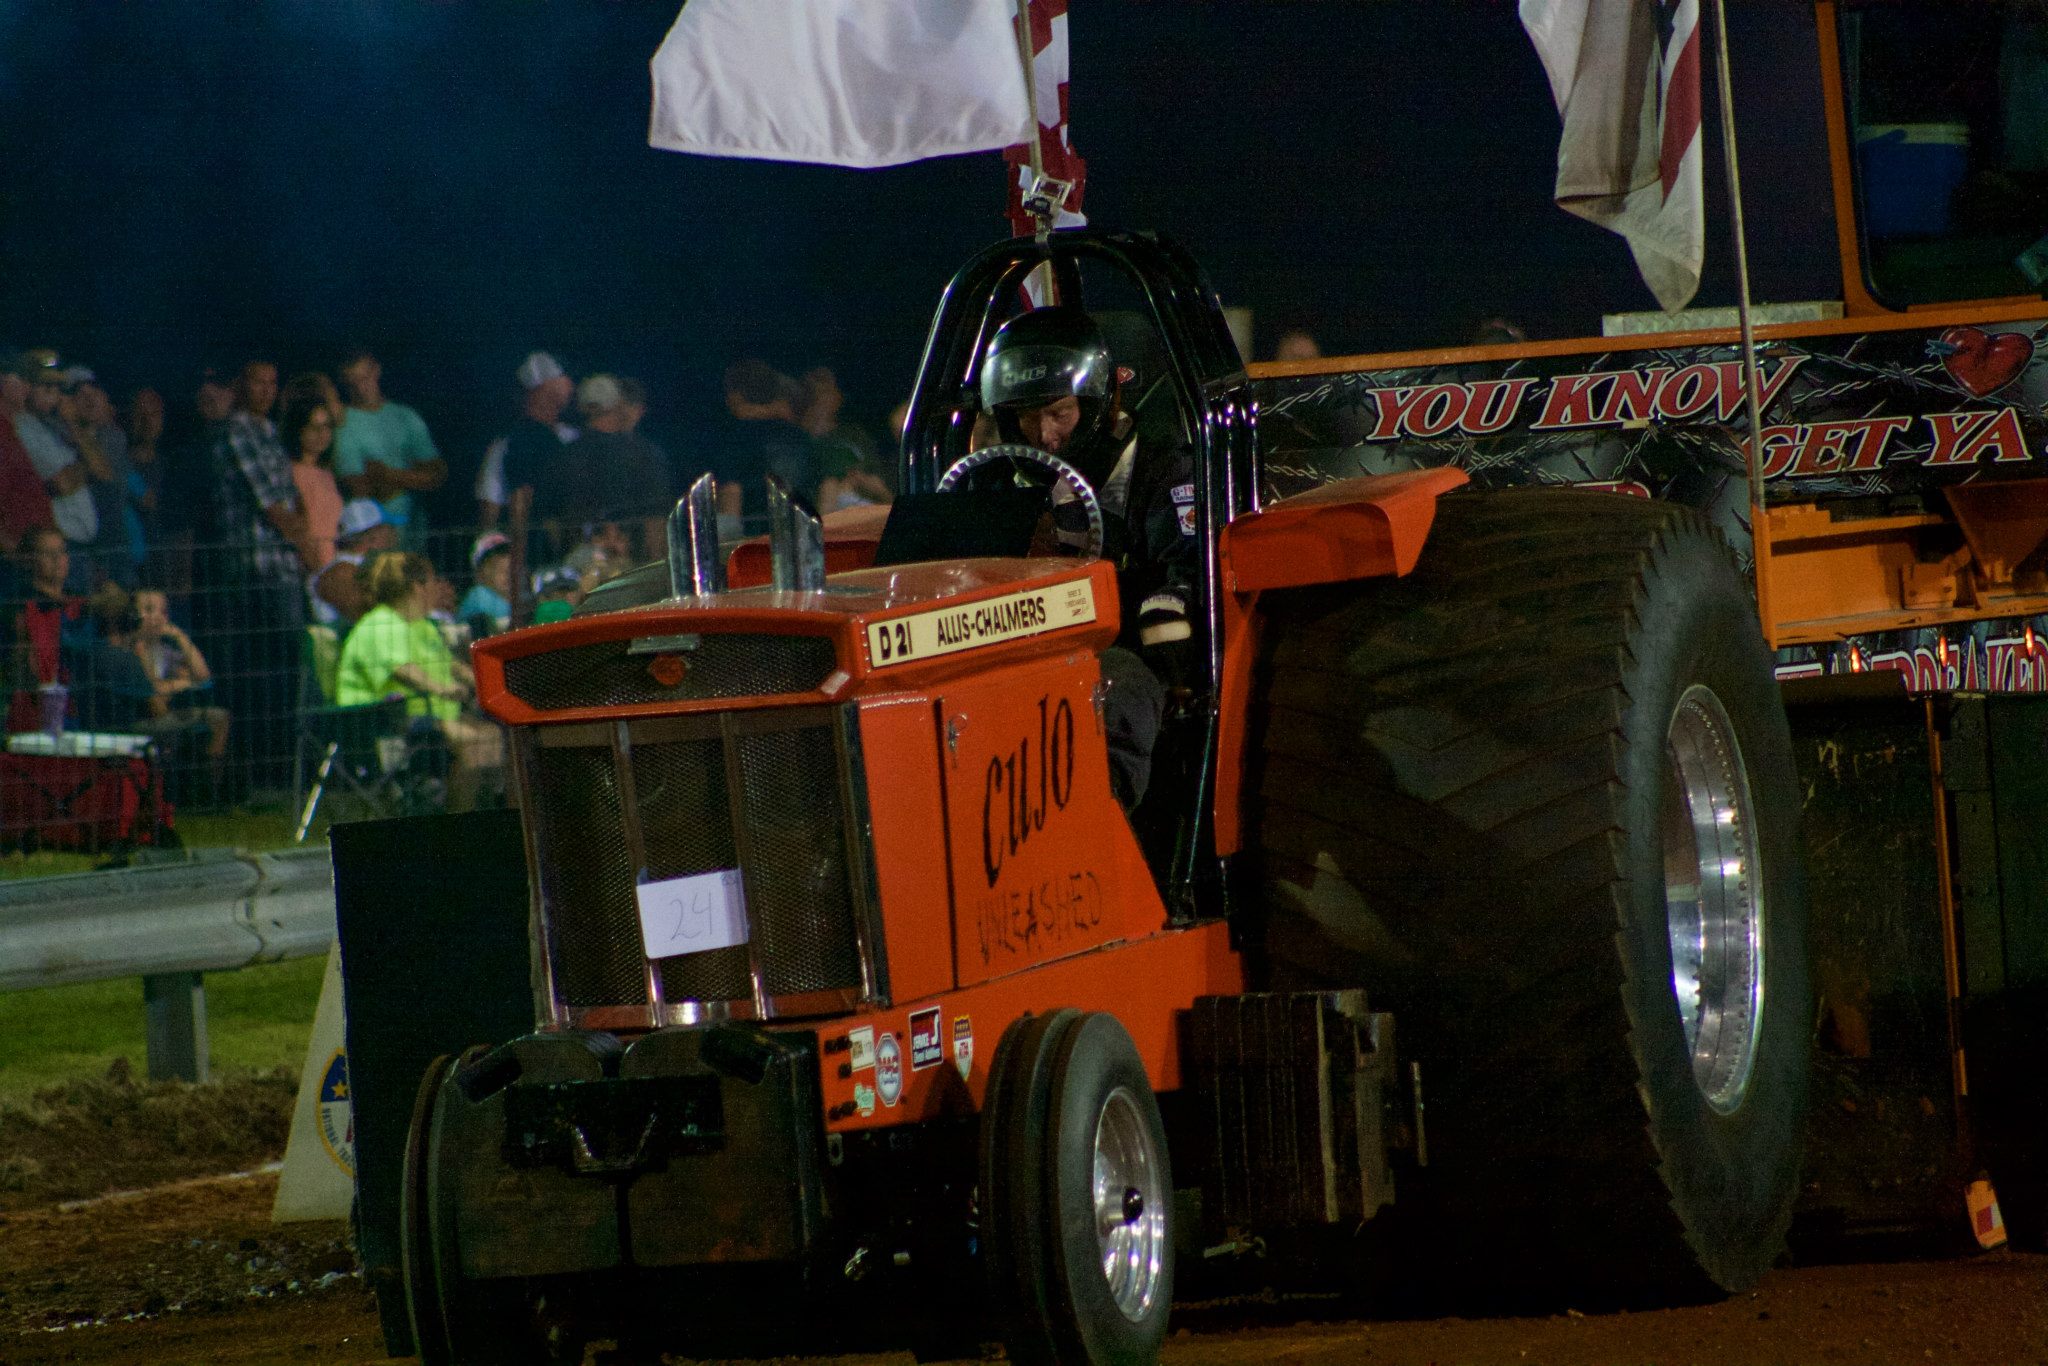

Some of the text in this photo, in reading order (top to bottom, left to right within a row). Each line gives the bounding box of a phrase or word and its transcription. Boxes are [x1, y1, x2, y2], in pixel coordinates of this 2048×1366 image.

[1366, 355, 1813, 441] YOU KNOW
[1743, 406, 2033, 480] GET YA
[879, 625, 892, 661] D
[895, 621, 913, 657] 21
[936, 596, 1047, 647] ALLIS-CHALMERS
[669, 887, 713, 941] 24
